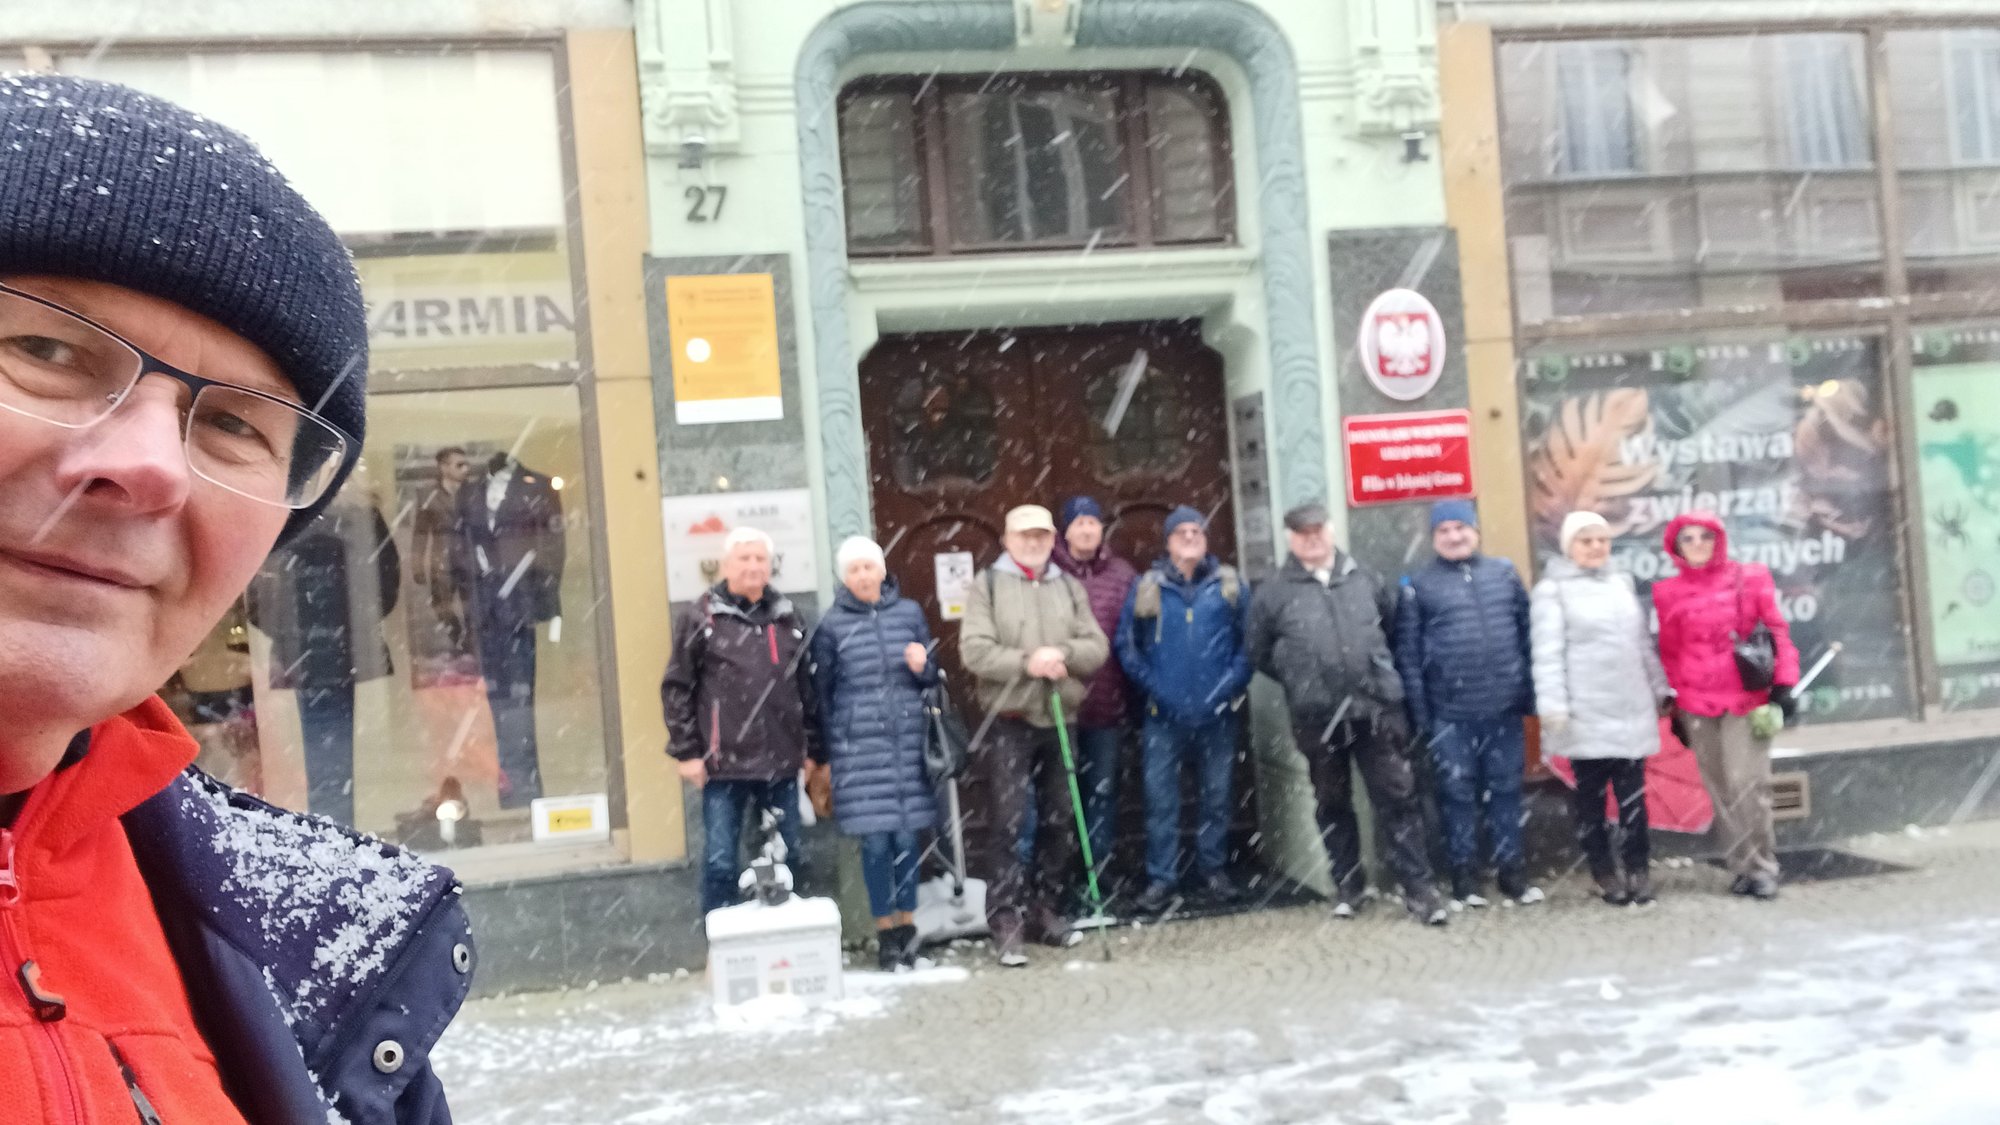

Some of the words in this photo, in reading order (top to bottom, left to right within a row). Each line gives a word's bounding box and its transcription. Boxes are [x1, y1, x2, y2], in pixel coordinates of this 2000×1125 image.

[685, 186, 727, 223] 27
[366, 295, 575, 338] ARMIA
[1619, 430, 1794, 474] Wystawa
